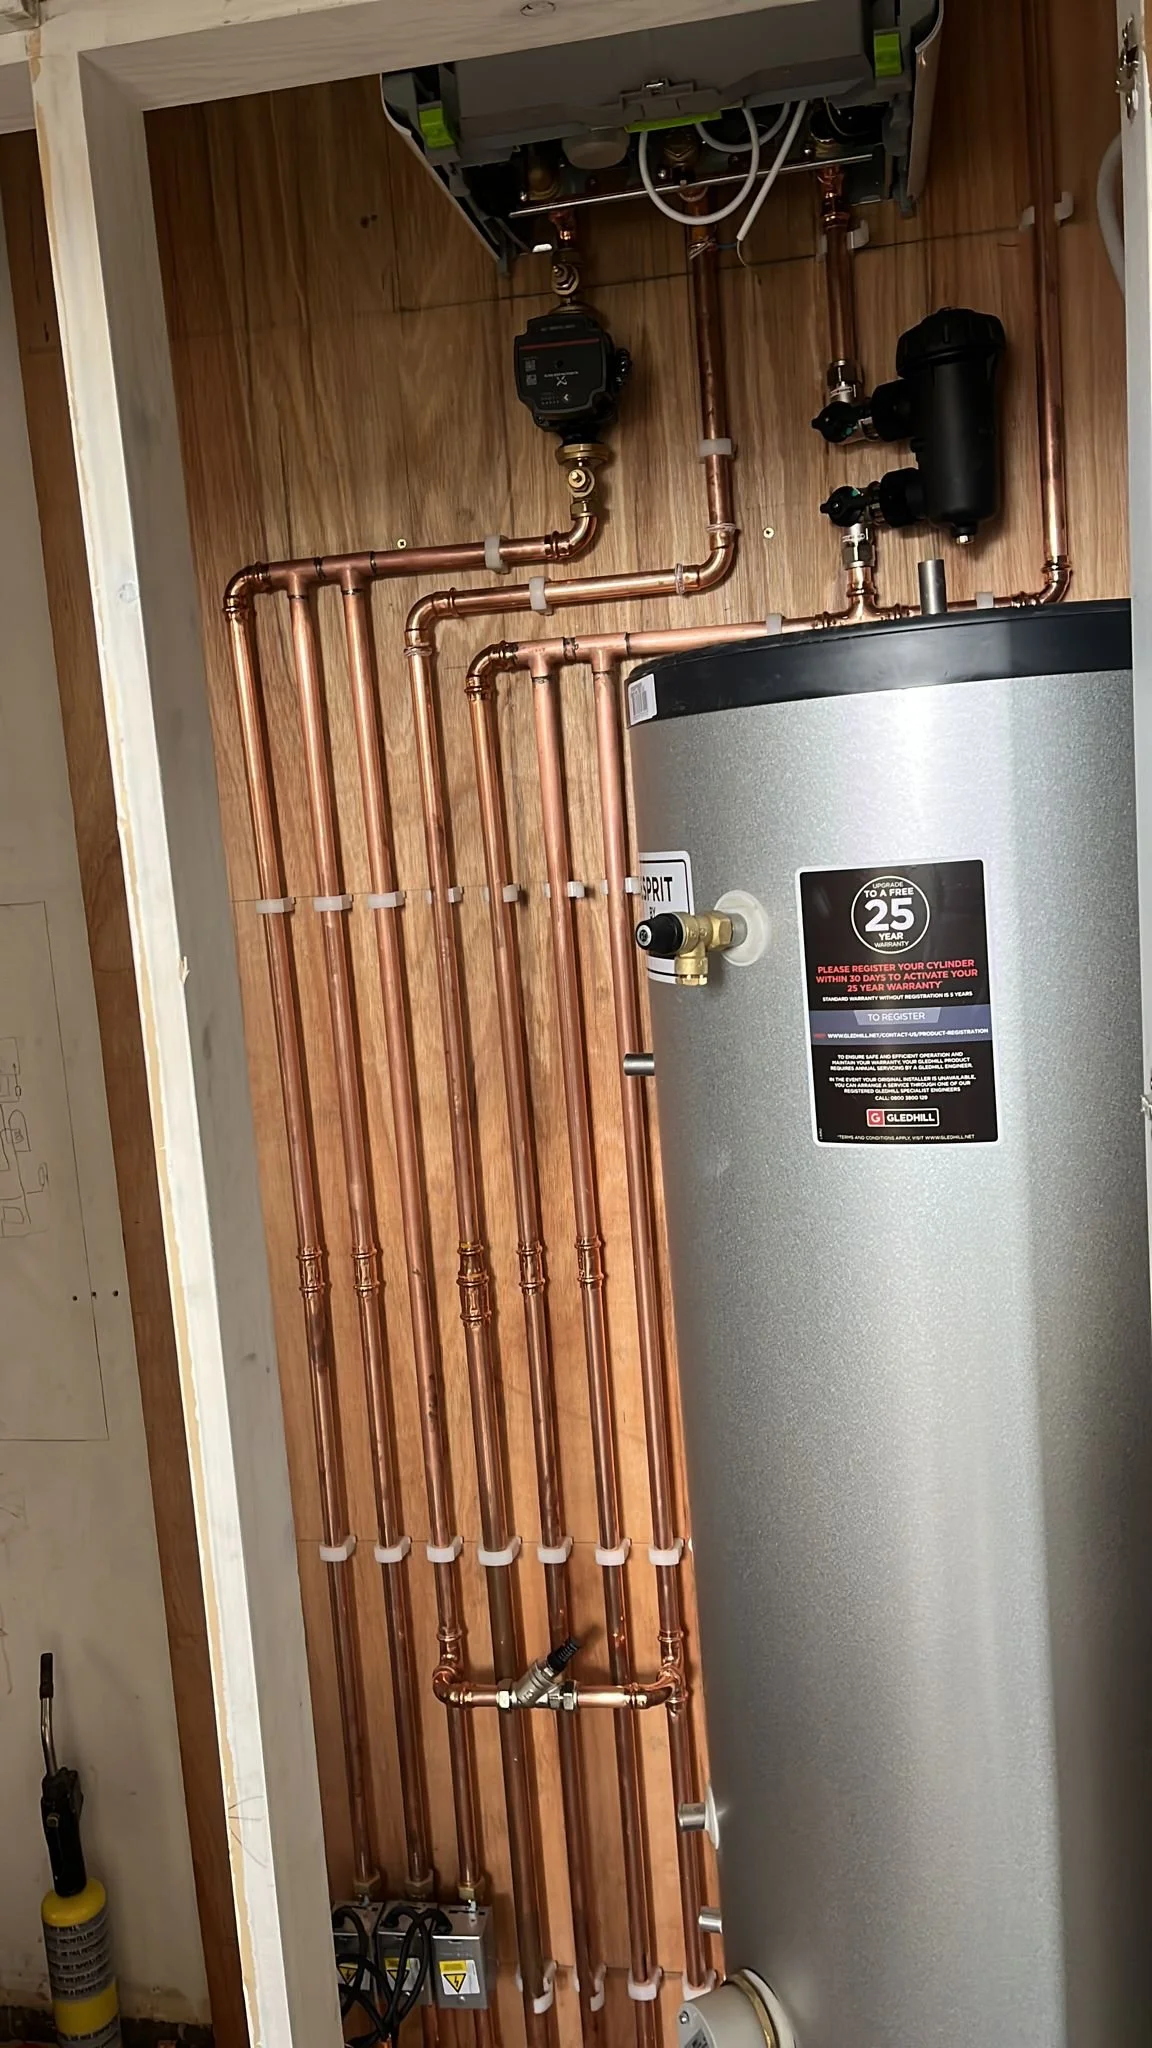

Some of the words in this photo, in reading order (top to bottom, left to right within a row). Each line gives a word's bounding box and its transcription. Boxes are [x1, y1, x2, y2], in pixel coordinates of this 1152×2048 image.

[641, 876, 672, 902] SPRIT
[864, 890, 877, 898] TO
[880, 889, 887, 897] A
[889, 888, 914, 896] FREE
[864, 897, 915, 932] 25
[879, 932, 904, 941] YEAR
[852, 964, 896, 972] REGISTER
[898, 962, 924, 970] YOUR
[927, 960, 975, 969] CYLINDER
[904, 971, 949, 980] ACTIVATE
[951, 969, 978, 978] YOUR
[882, 1012, 925, 1021] REGISTER
[828, 1028, 988, 1038] WWW.GLEDHILL.NET/CONTACT-US/PRODUCT-REGISTRATION
[871, 1113, 880, 1122] G
[887, 1113, 935, 1122] GLEDHILL
